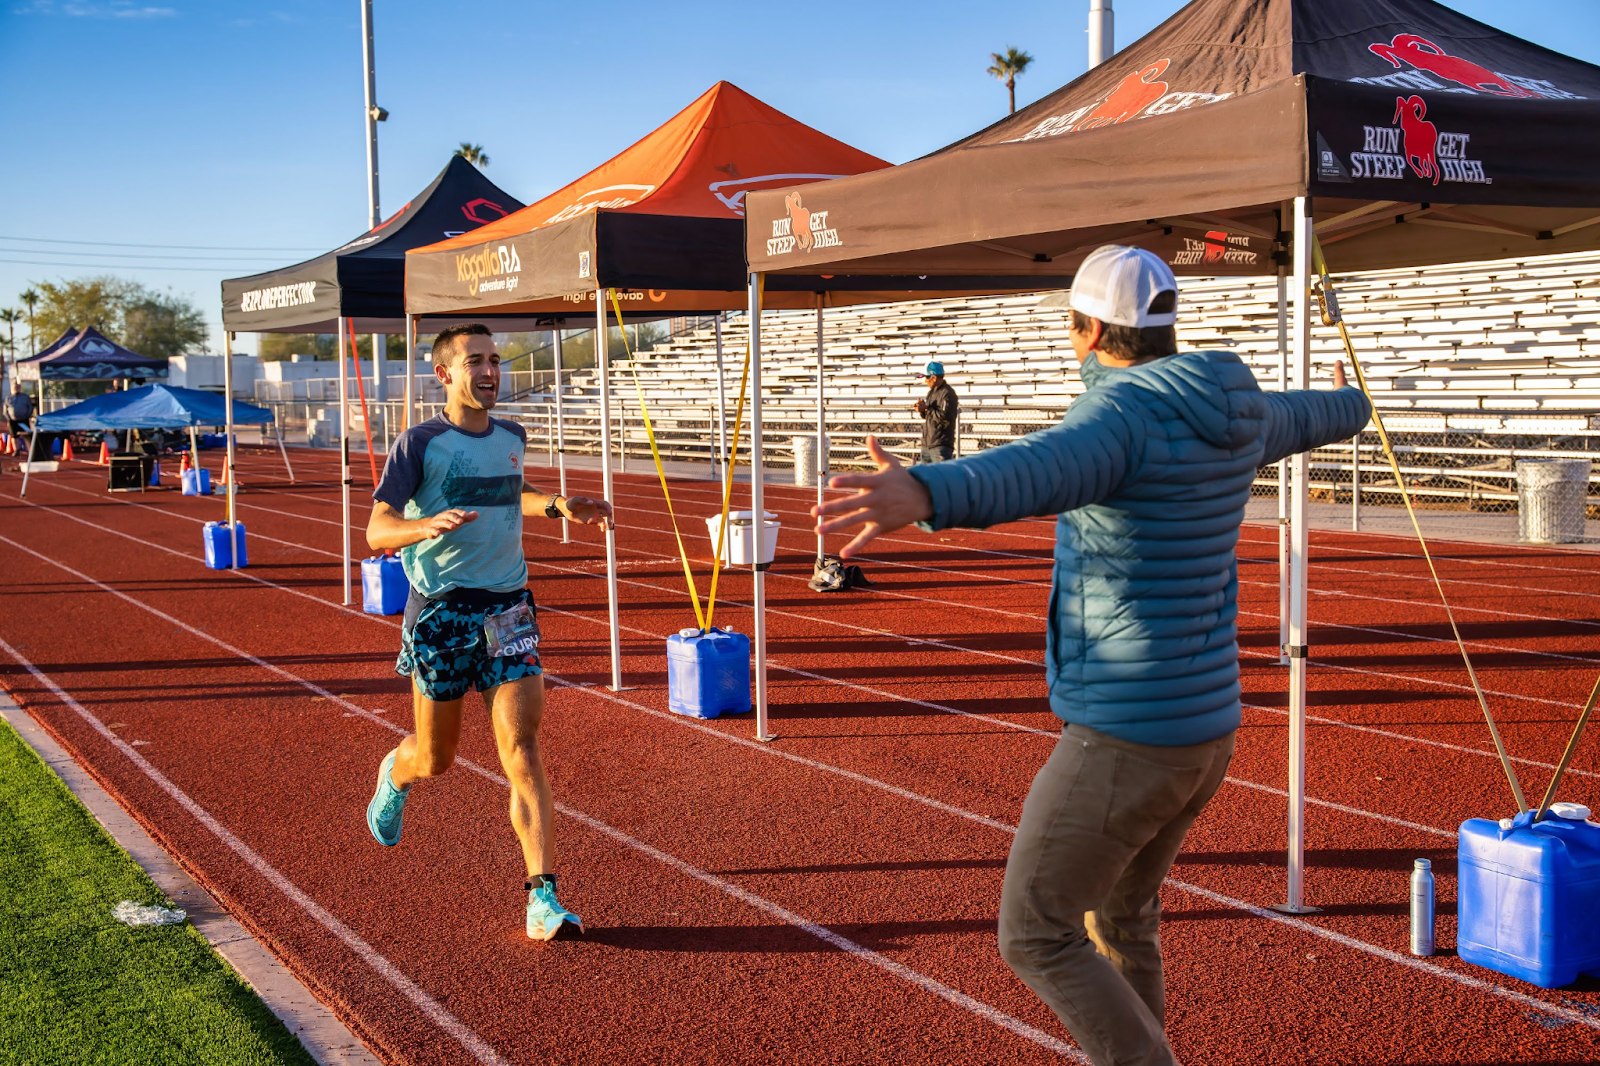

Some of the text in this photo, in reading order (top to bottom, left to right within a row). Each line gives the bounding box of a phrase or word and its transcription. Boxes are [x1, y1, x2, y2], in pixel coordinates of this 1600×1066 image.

[1363, 125, 1470, 159] RUN GET
[1349, 151, 1407, 180] STEEP
[1440, 158, 1486, 183] HIGH
[772, 210, 829, 238] RUN GET
[766, 235, 796, 257] STEEP
[478, 275, 519, 293] adventure light
